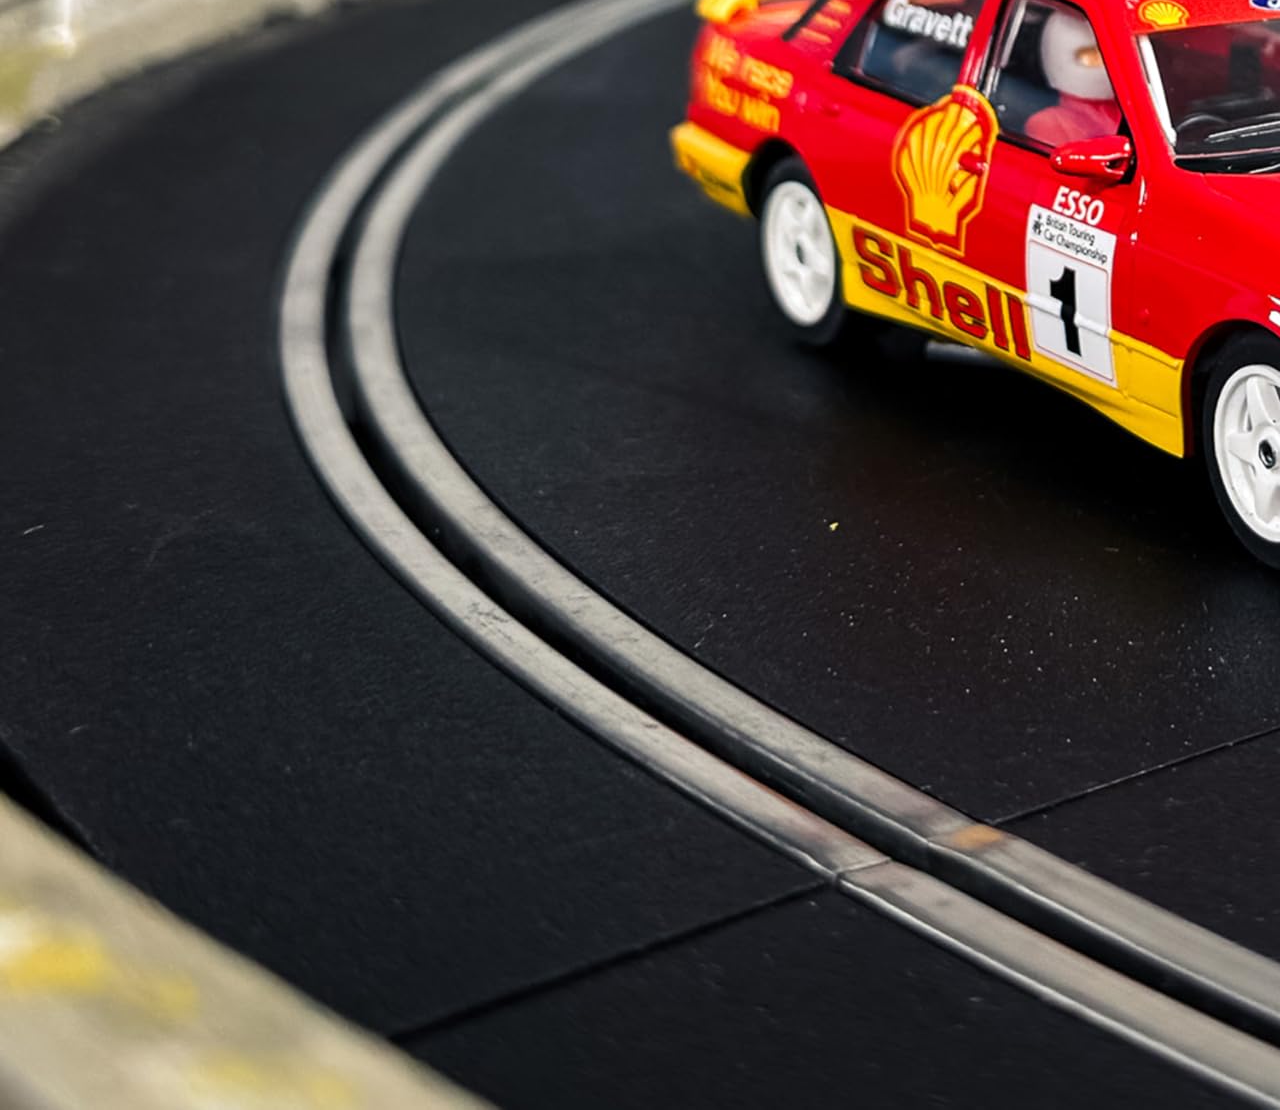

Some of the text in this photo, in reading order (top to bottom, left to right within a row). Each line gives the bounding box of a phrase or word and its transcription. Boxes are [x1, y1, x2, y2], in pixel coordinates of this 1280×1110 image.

[742, 55, 794, 99] race
[1052, 185, 1105, 226] ESSO
[1043, 228, 1108, 265] Car Championship
[1045, 214, 1096, 247] British Touring
[852, 224, 1032, 362] Shell
[1049, 266, 1082, 357] 1
